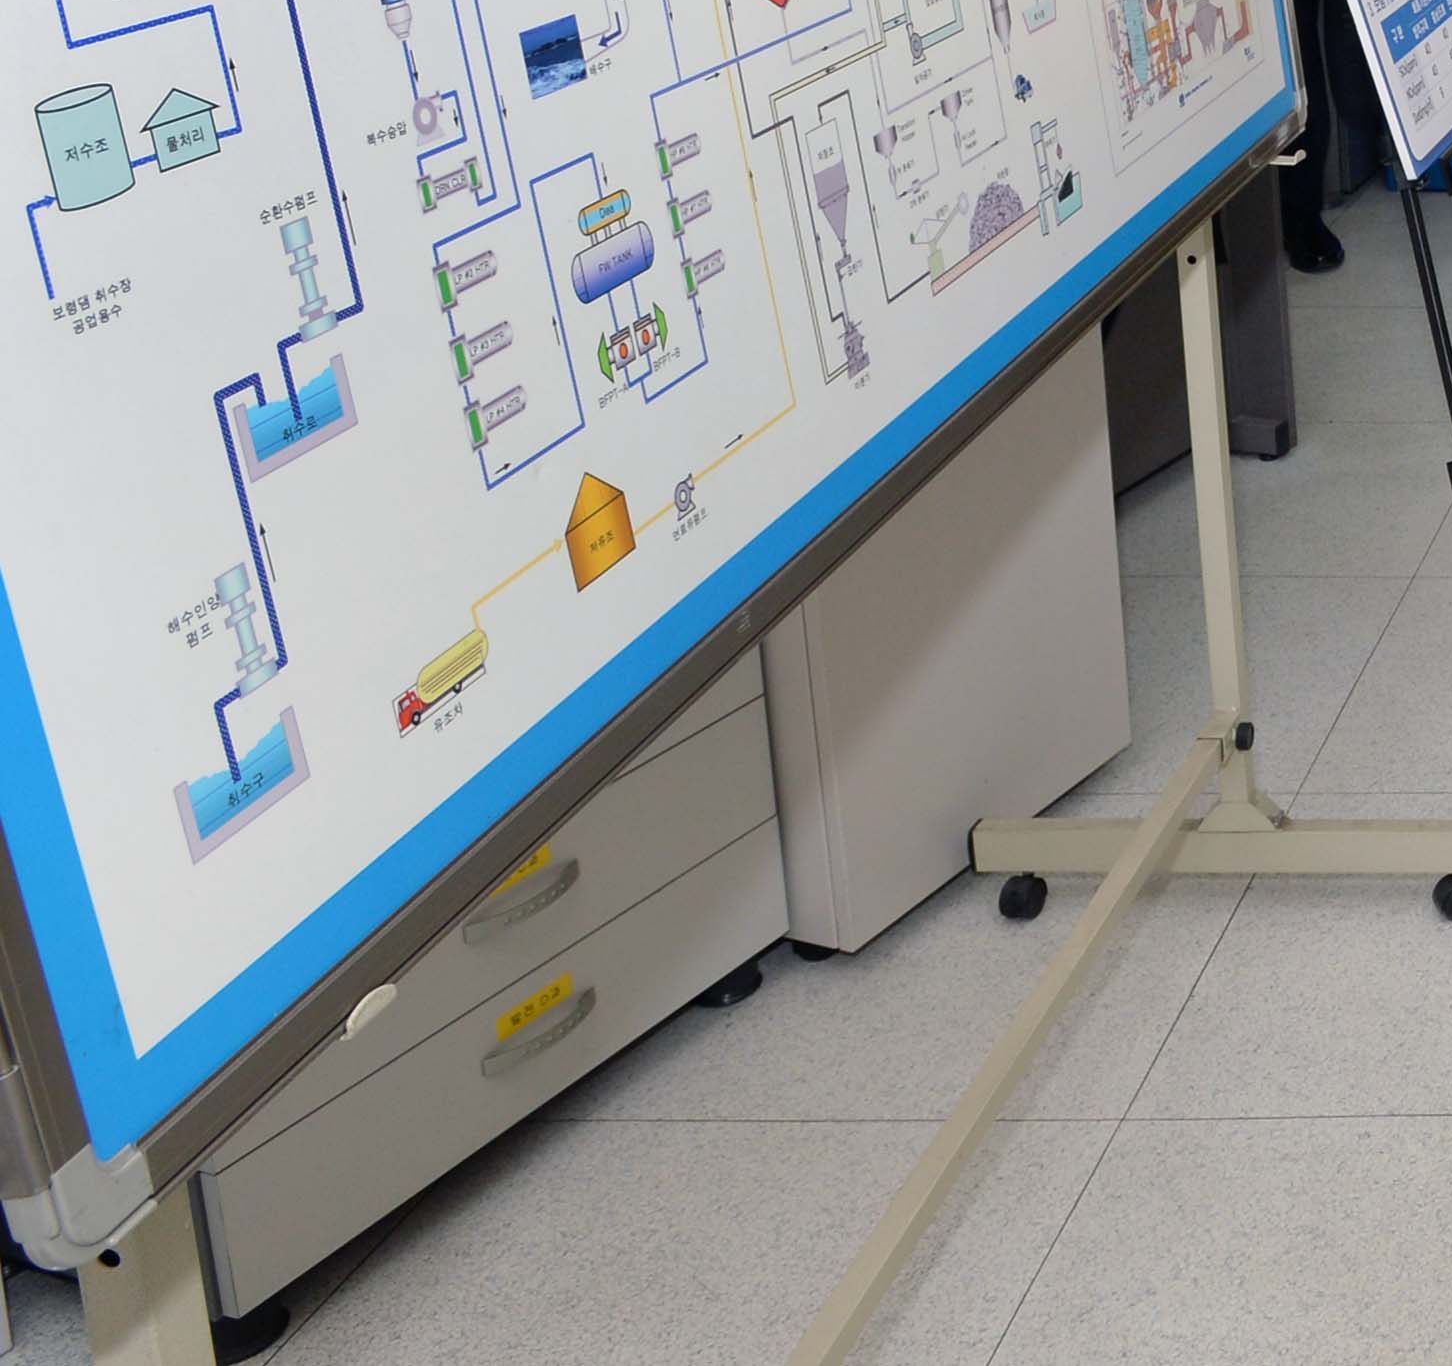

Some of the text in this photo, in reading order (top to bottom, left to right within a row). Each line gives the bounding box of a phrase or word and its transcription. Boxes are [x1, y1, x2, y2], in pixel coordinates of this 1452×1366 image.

[64, 137, 110, 163] 저수조
[166, 126, 206, 154] 물처리
[366, 121, 408, 147] 복수승압
[259, 190, 319, 225] 순환수펌프
[52, 277, 133, 322] 보령댐 취수장
[71, 303, 123, 336] 공업용수
[166, 593, 222, 636] 해수인양
[185, 621, 215, 649] 펌프
[226, 771, 266, 809] 취수구
